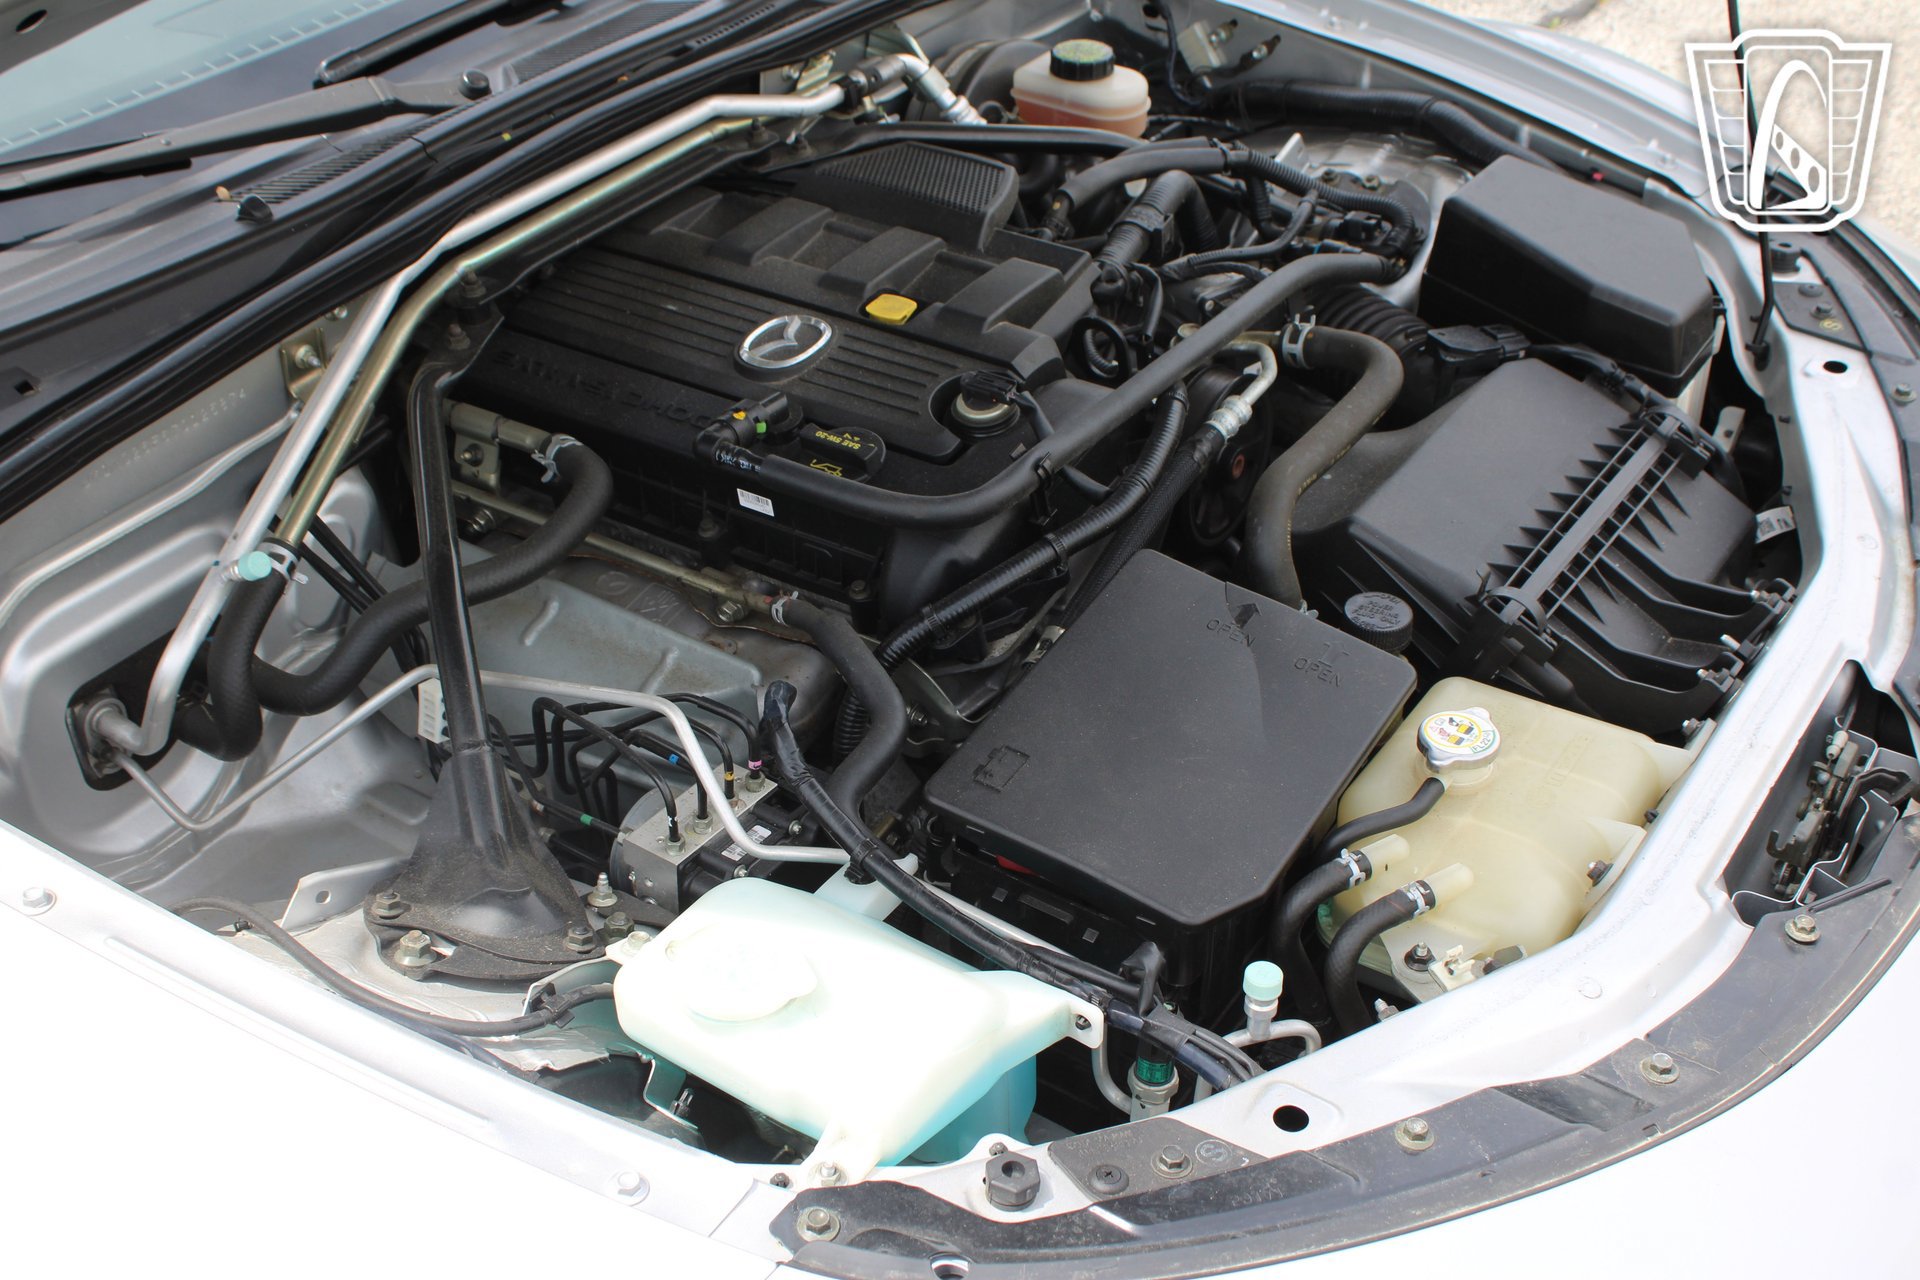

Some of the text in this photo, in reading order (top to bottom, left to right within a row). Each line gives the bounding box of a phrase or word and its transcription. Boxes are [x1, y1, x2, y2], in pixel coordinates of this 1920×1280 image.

[815, 430, 861, 450] SAE 5W-20
[1351, 608, 1376, 620] FLUID
[1358, 604, 1400, 619] STEERING
[1367, 600, 1394, 612] POWER
[1206, 618, 1256, 648] OPEN
[1294, 657, 1342, 688] OPEN
